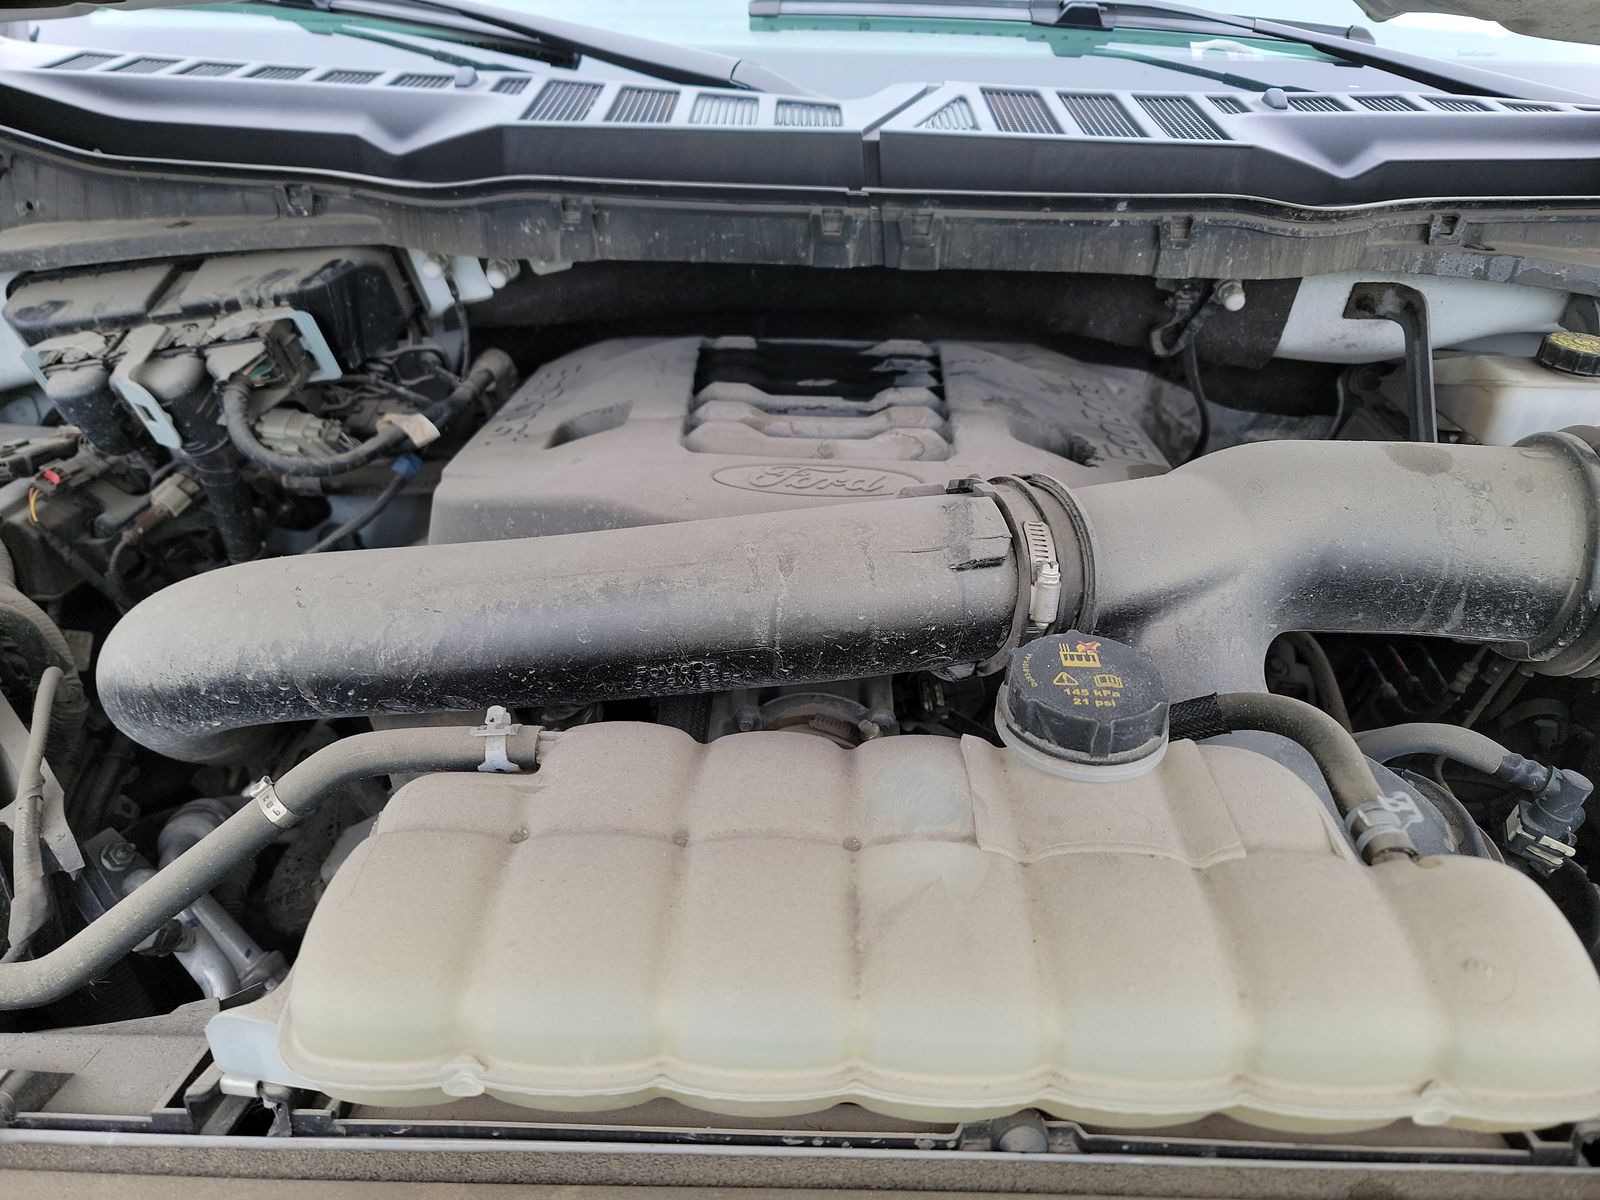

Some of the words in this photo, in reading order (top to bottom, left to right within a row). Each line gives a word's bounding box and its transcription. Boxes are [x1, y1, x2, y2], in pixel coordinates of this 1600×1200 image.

[750, 466, 887, 493] Ford
[1063, 688, 1089, 696] 145
[1093, 689, 1120, 698] kPa
[1073, 697, 1089, 706] 21
[1094, 699, 1116, 707] psi
